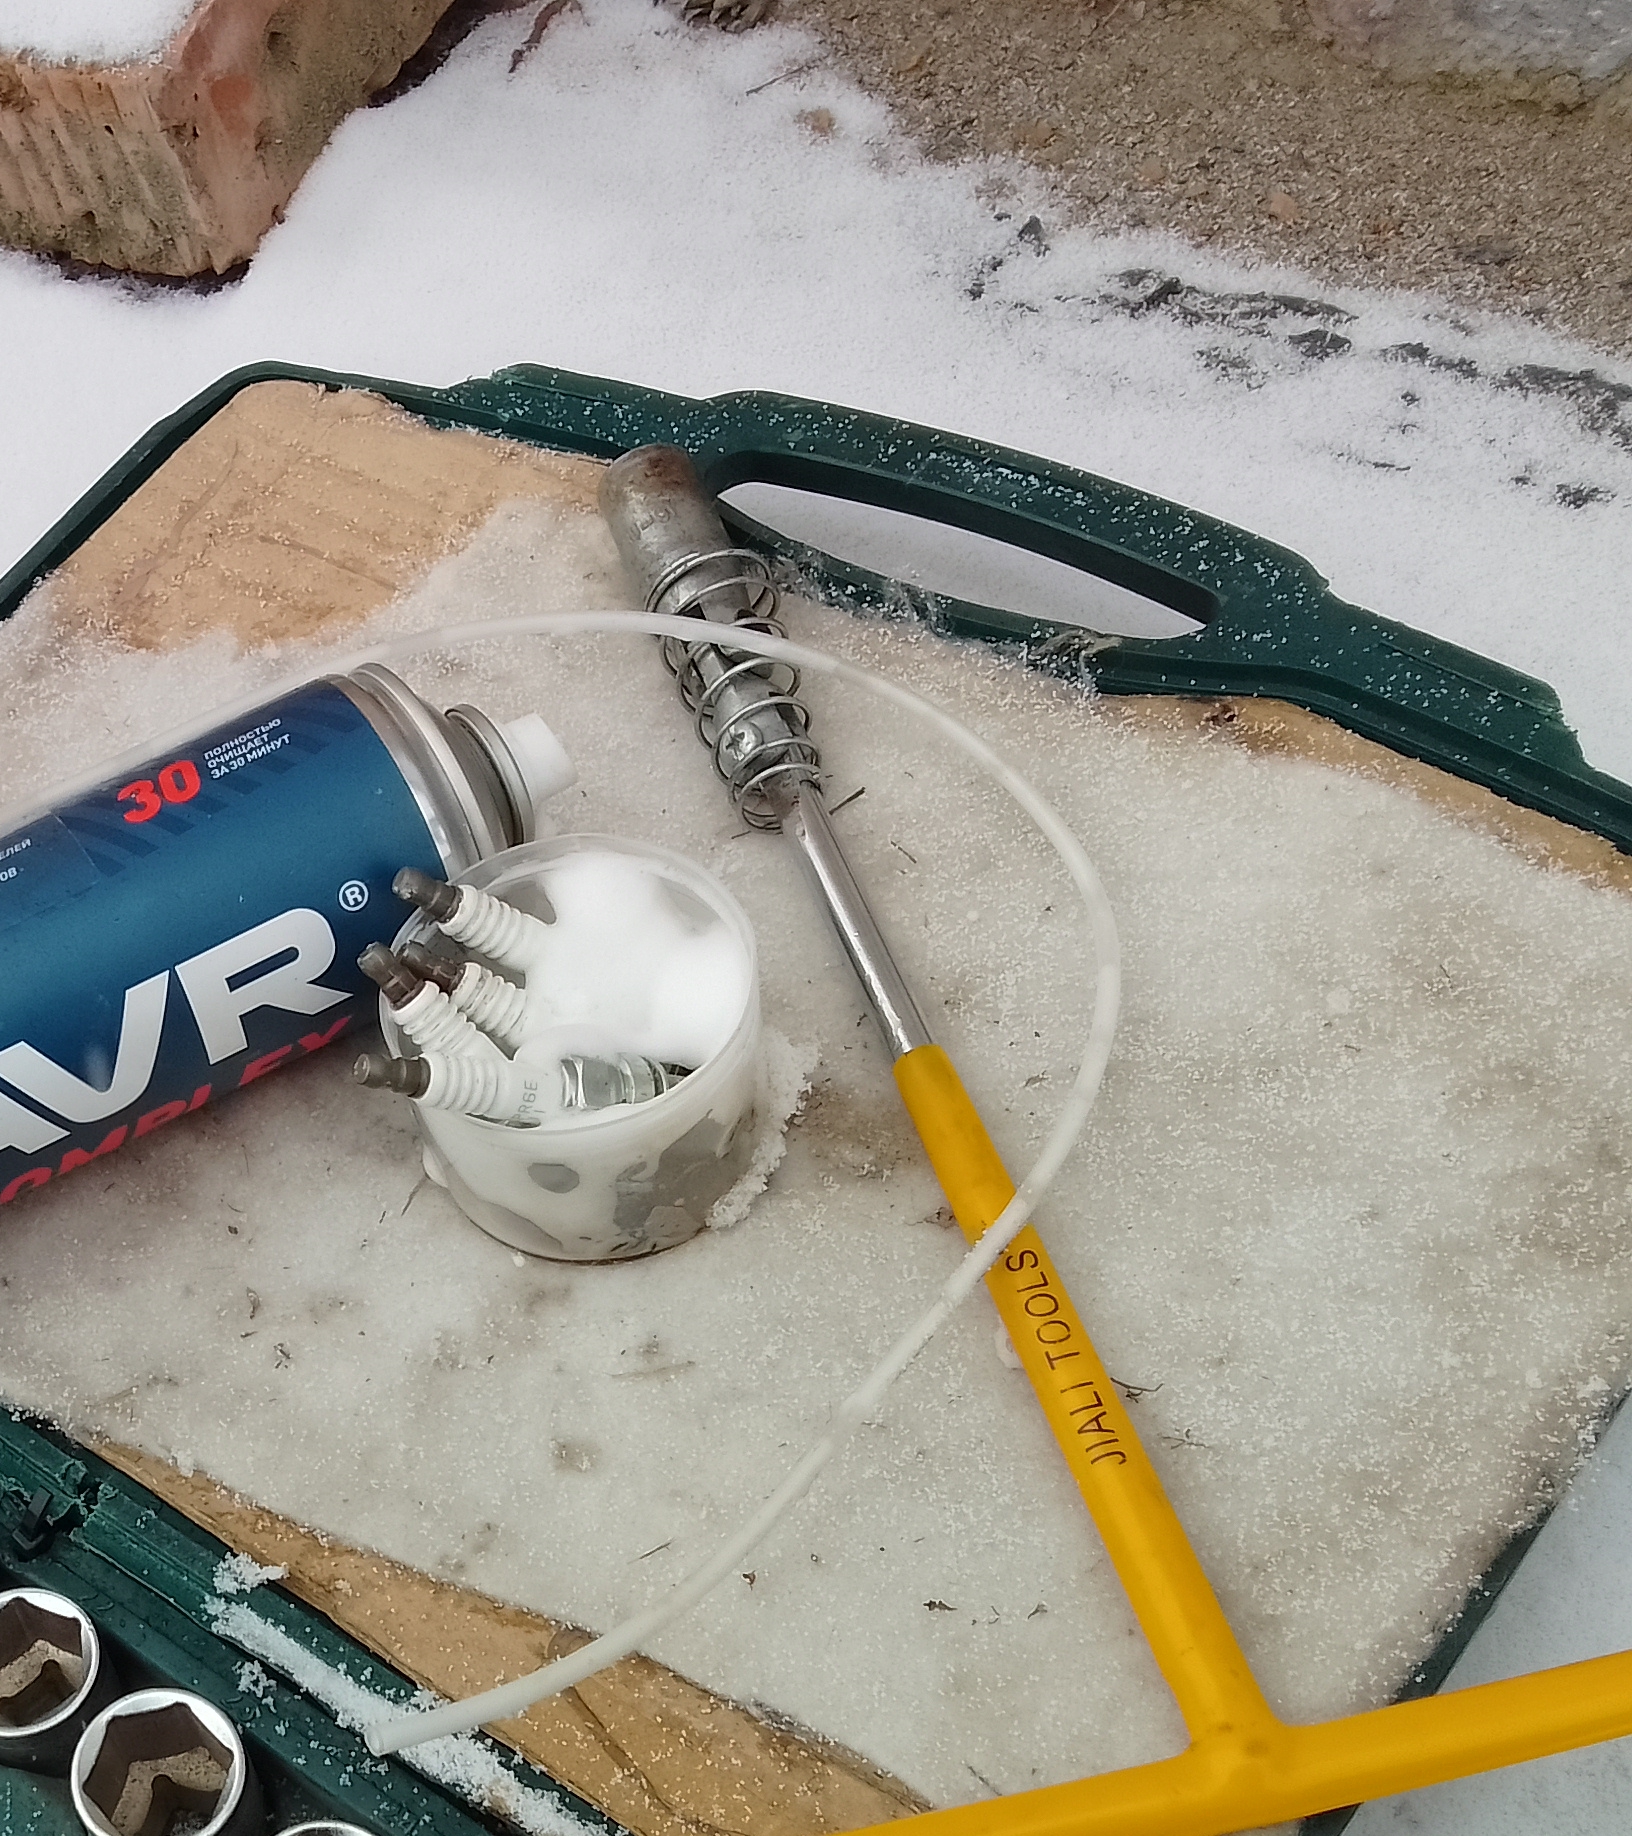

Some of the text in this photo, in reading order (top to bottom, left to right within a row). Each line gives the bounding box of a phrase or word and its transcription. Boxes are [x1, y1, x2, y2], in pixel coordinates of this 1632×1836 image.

[203, 718, 282, 761] ПОЛНОСТЬЮ
[207, 732, 270, 770] ОЧИЩАЕТ
[210, 733, 291, 780] ЗА 30 МИНУТ
[116, 759, 202, 824] 30
[1005, 1249, 1127, 1466] JIALI TOOLS
